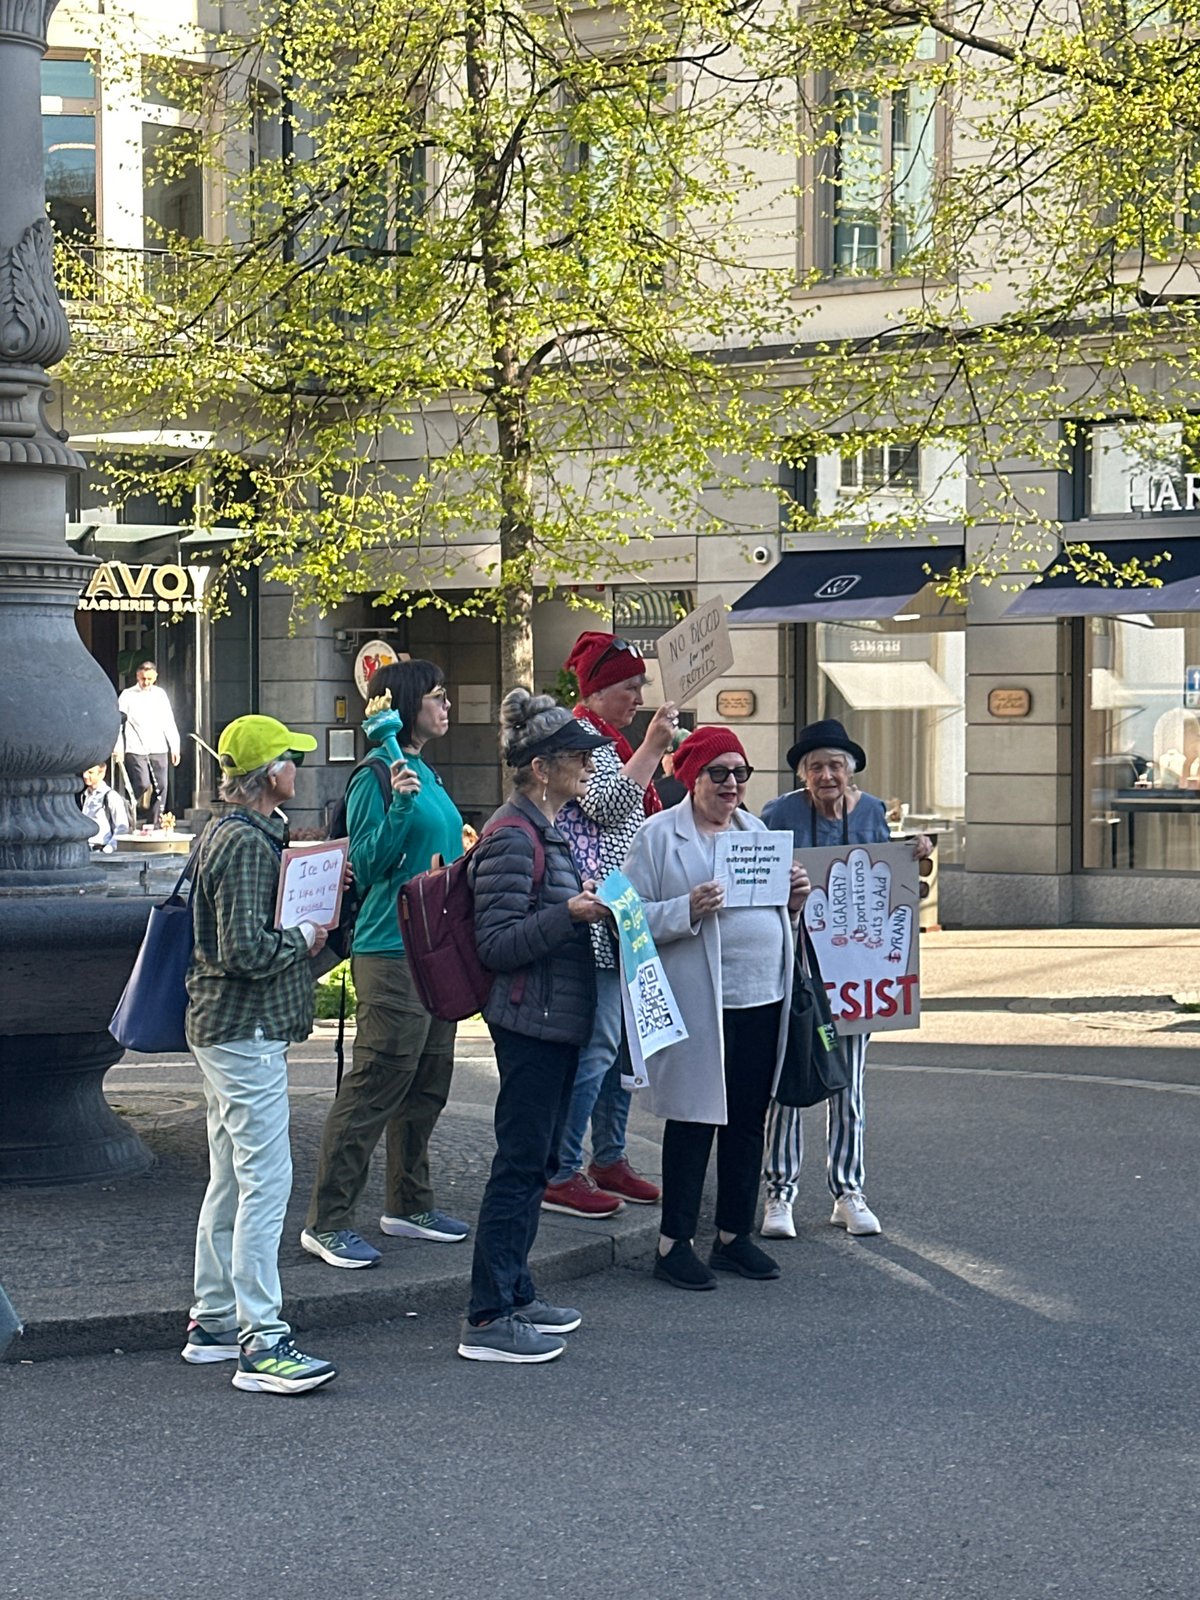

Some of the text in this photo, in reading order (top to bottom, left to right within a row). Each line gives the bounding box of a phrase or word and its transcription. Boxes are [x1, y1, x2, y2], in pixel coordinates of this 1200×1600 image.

[77, 598, 204, 613] RASSERIE & BAR
[79, 562, 211, 600] AVOY
[669, 608, 720, 663] NO BLOOD
[690, 640, 714, 667] for your
[830, 874, 849, 949] OLIGARCHY
[850, 859, 869, 943] Deportations
[864, 876, 888, 950] Cuts to Aid
[883, 906, 908, 964] TYRANNY
